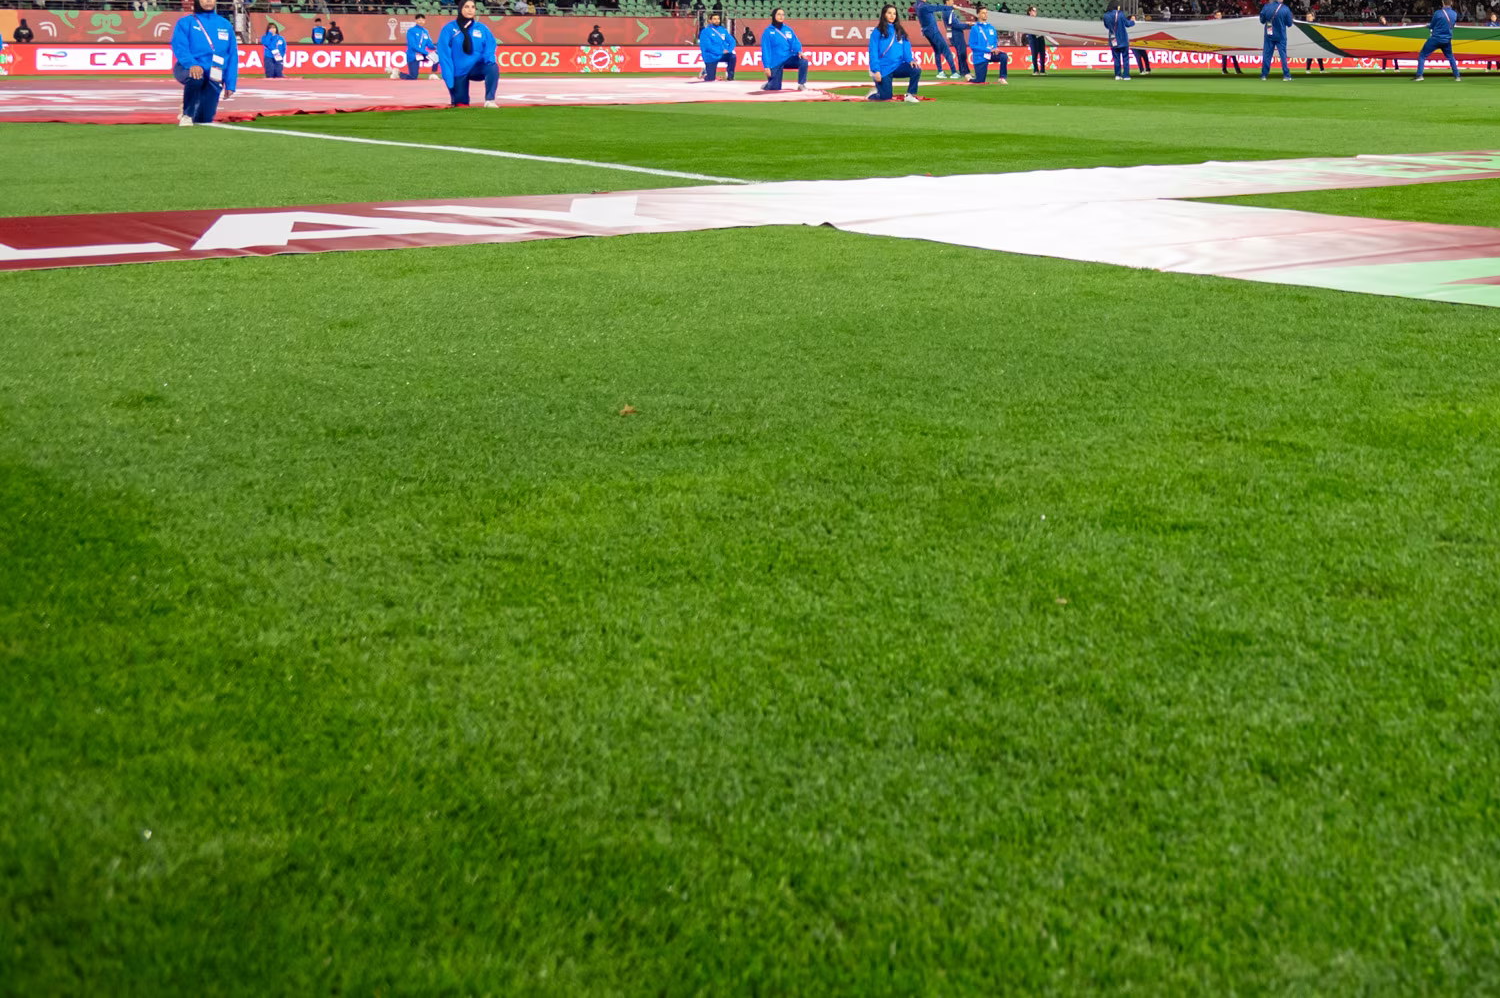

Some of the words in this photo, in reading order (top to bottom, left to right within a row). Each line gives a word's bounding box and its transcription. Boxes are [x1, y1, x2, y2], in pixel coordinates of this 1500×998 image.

[90, 52, 157, 66] CAF
[283, 50, 309, 68] UP
[312, 50, 341, 68] OF
[345, 50, 433, 68] NATIO
[540, 51, 560, 67] 25
[677, 53, 704, 65] CA
[834, 51, 856, 66] OF
